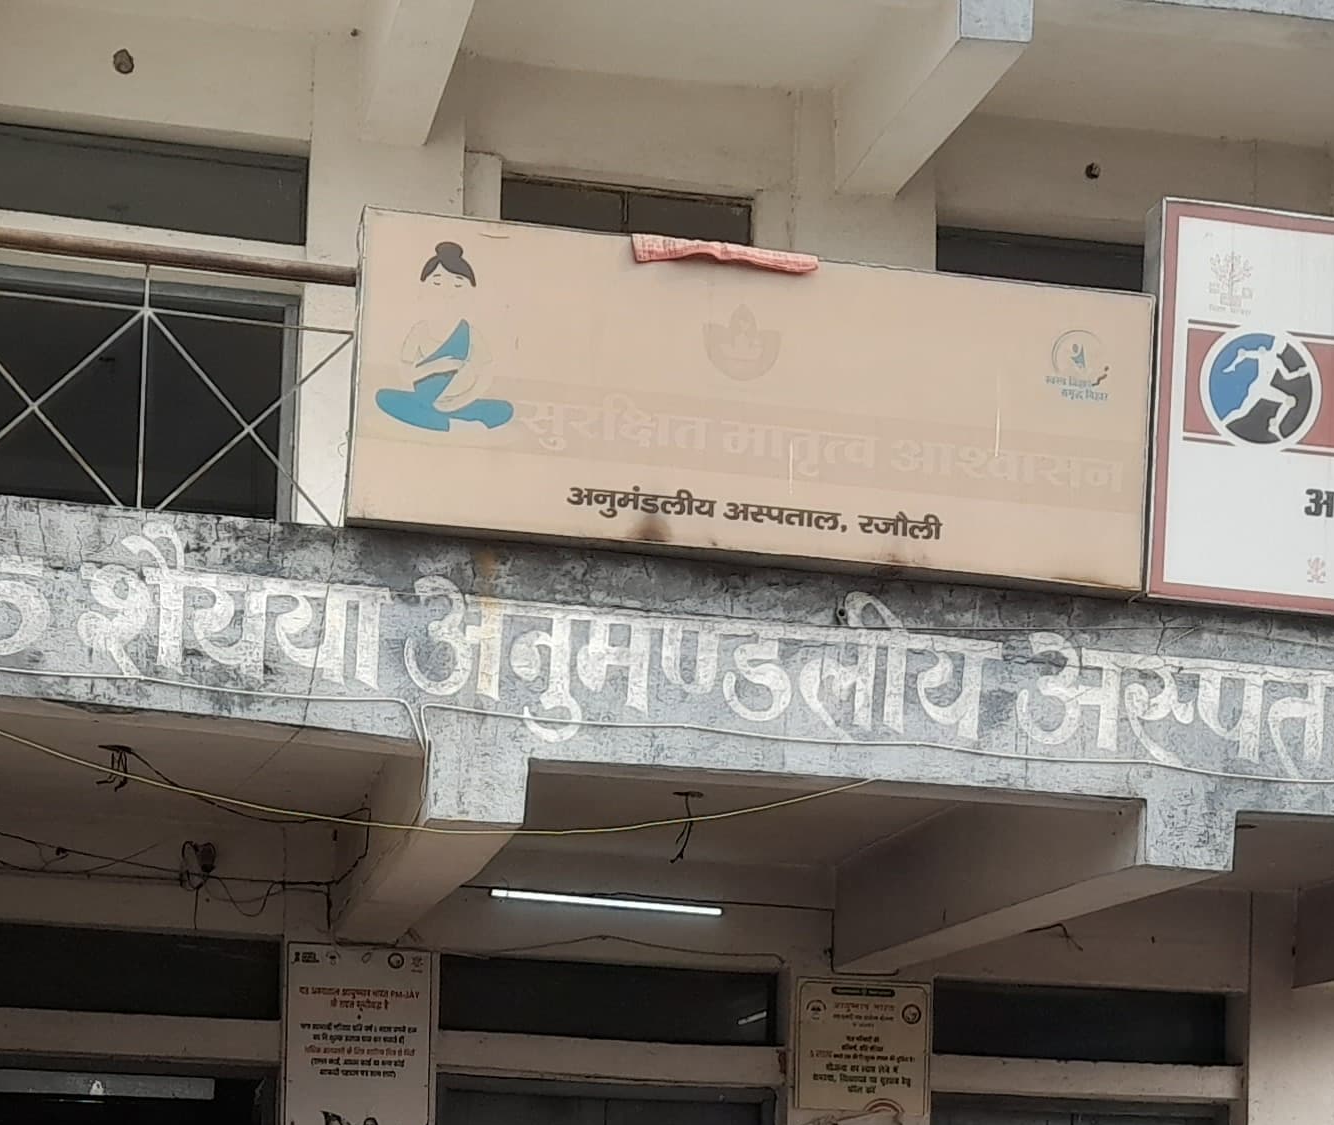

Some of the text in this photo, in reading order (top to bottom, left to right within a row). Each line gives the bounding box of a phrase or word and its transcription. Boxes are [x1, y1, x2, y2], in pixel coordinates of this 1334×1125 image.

[517, 394, 1124, 493] सुरक्षित मातृत्व आश्वासन
[566, 484, 942, 540] अनुमंडलीय अस्पताल, रजौली
[404, 575, 1003, 742] अनुमण्डलीय
